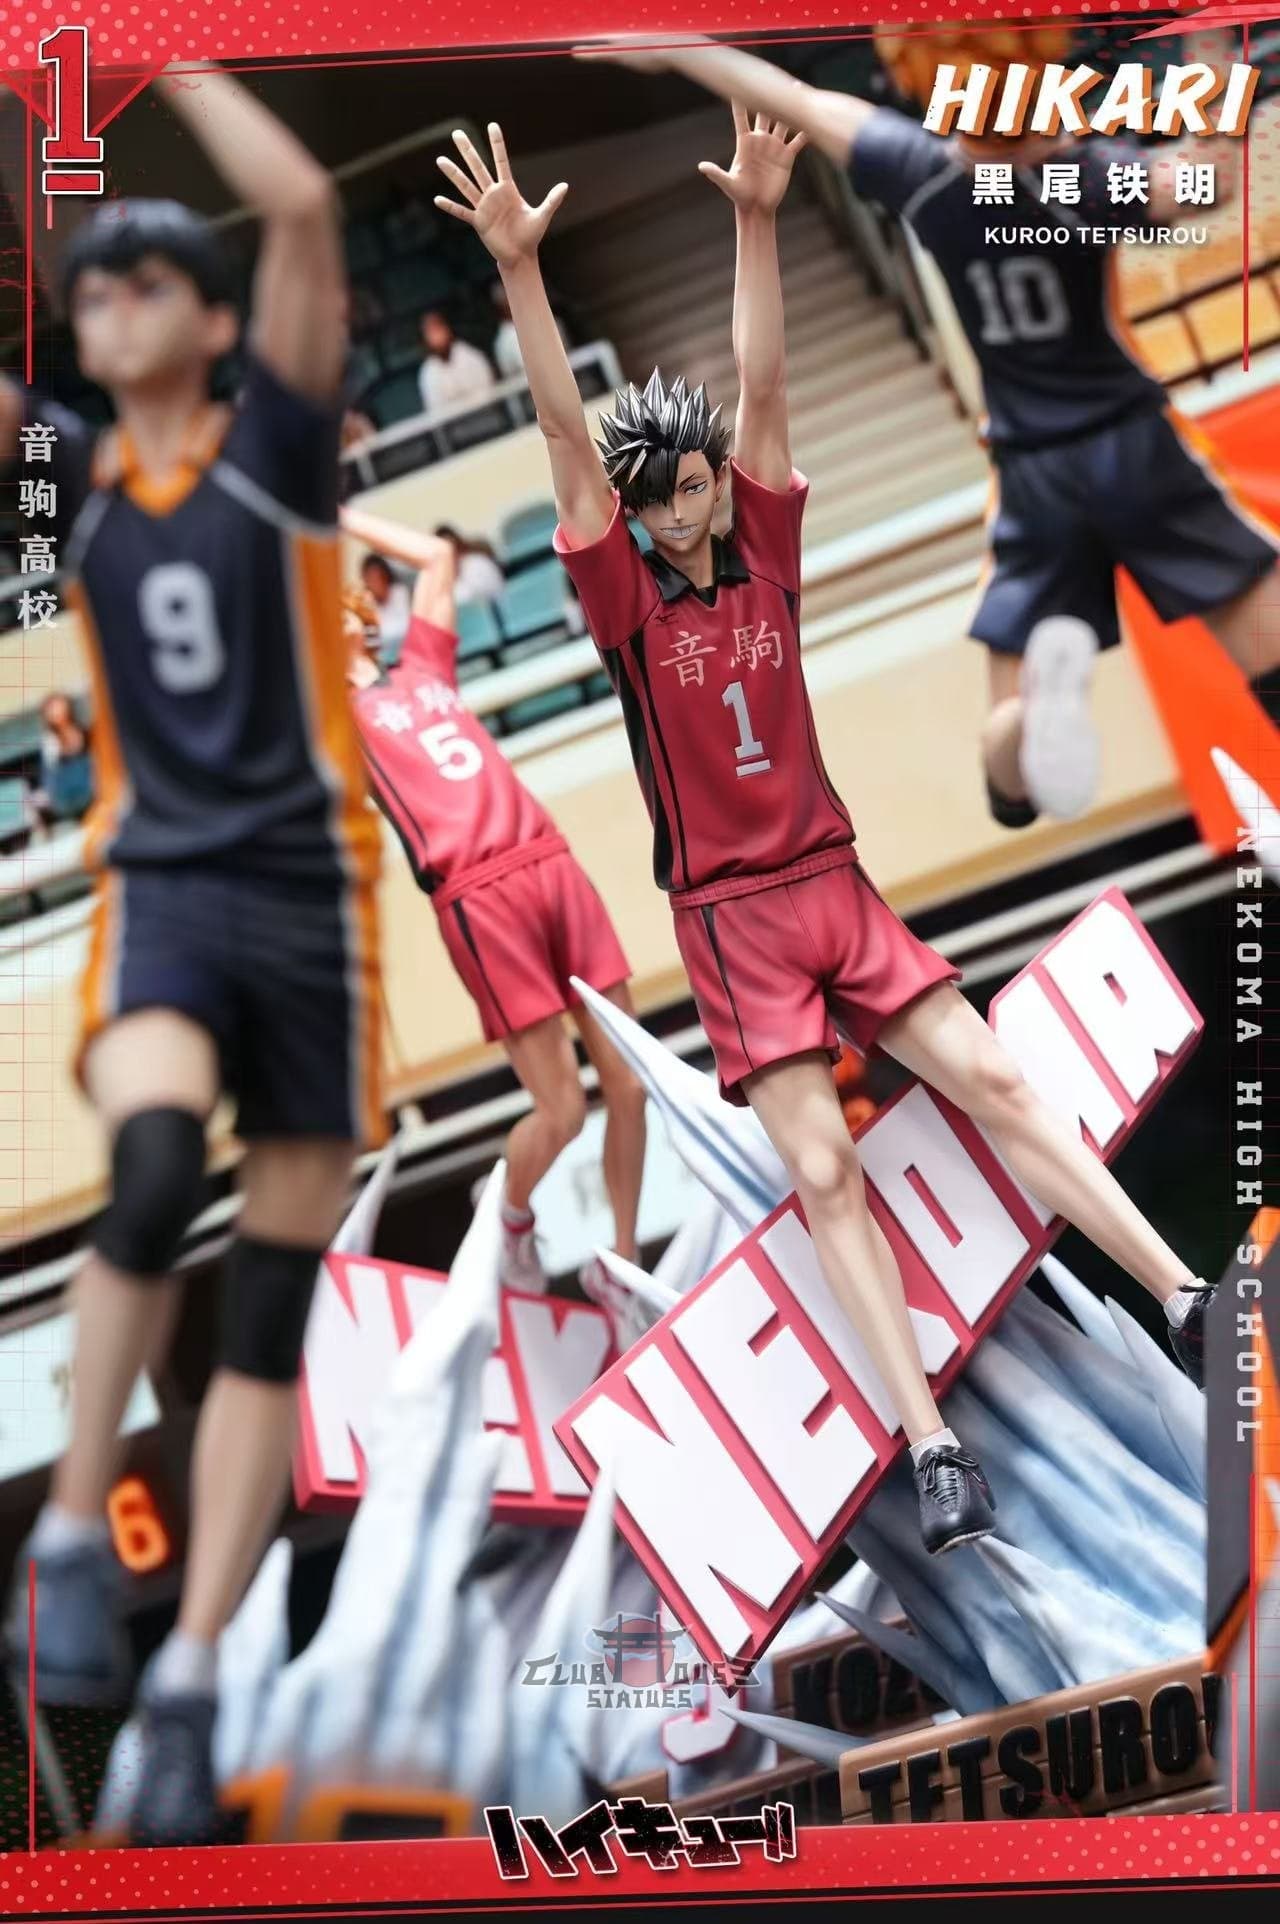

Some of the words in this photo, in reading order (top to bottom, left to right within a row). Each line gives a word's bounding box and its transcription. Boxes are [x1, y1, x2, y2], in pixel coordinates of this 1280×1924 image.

[965, 252, 1071, 345] 10
[138, 562, 226, 694] 9
[659, 620, 784, 687] 音駒
[418, 720, 483, 782] 5
[721, 681, 764, 760] 1
[106, 1476, 169, 1572] 6
